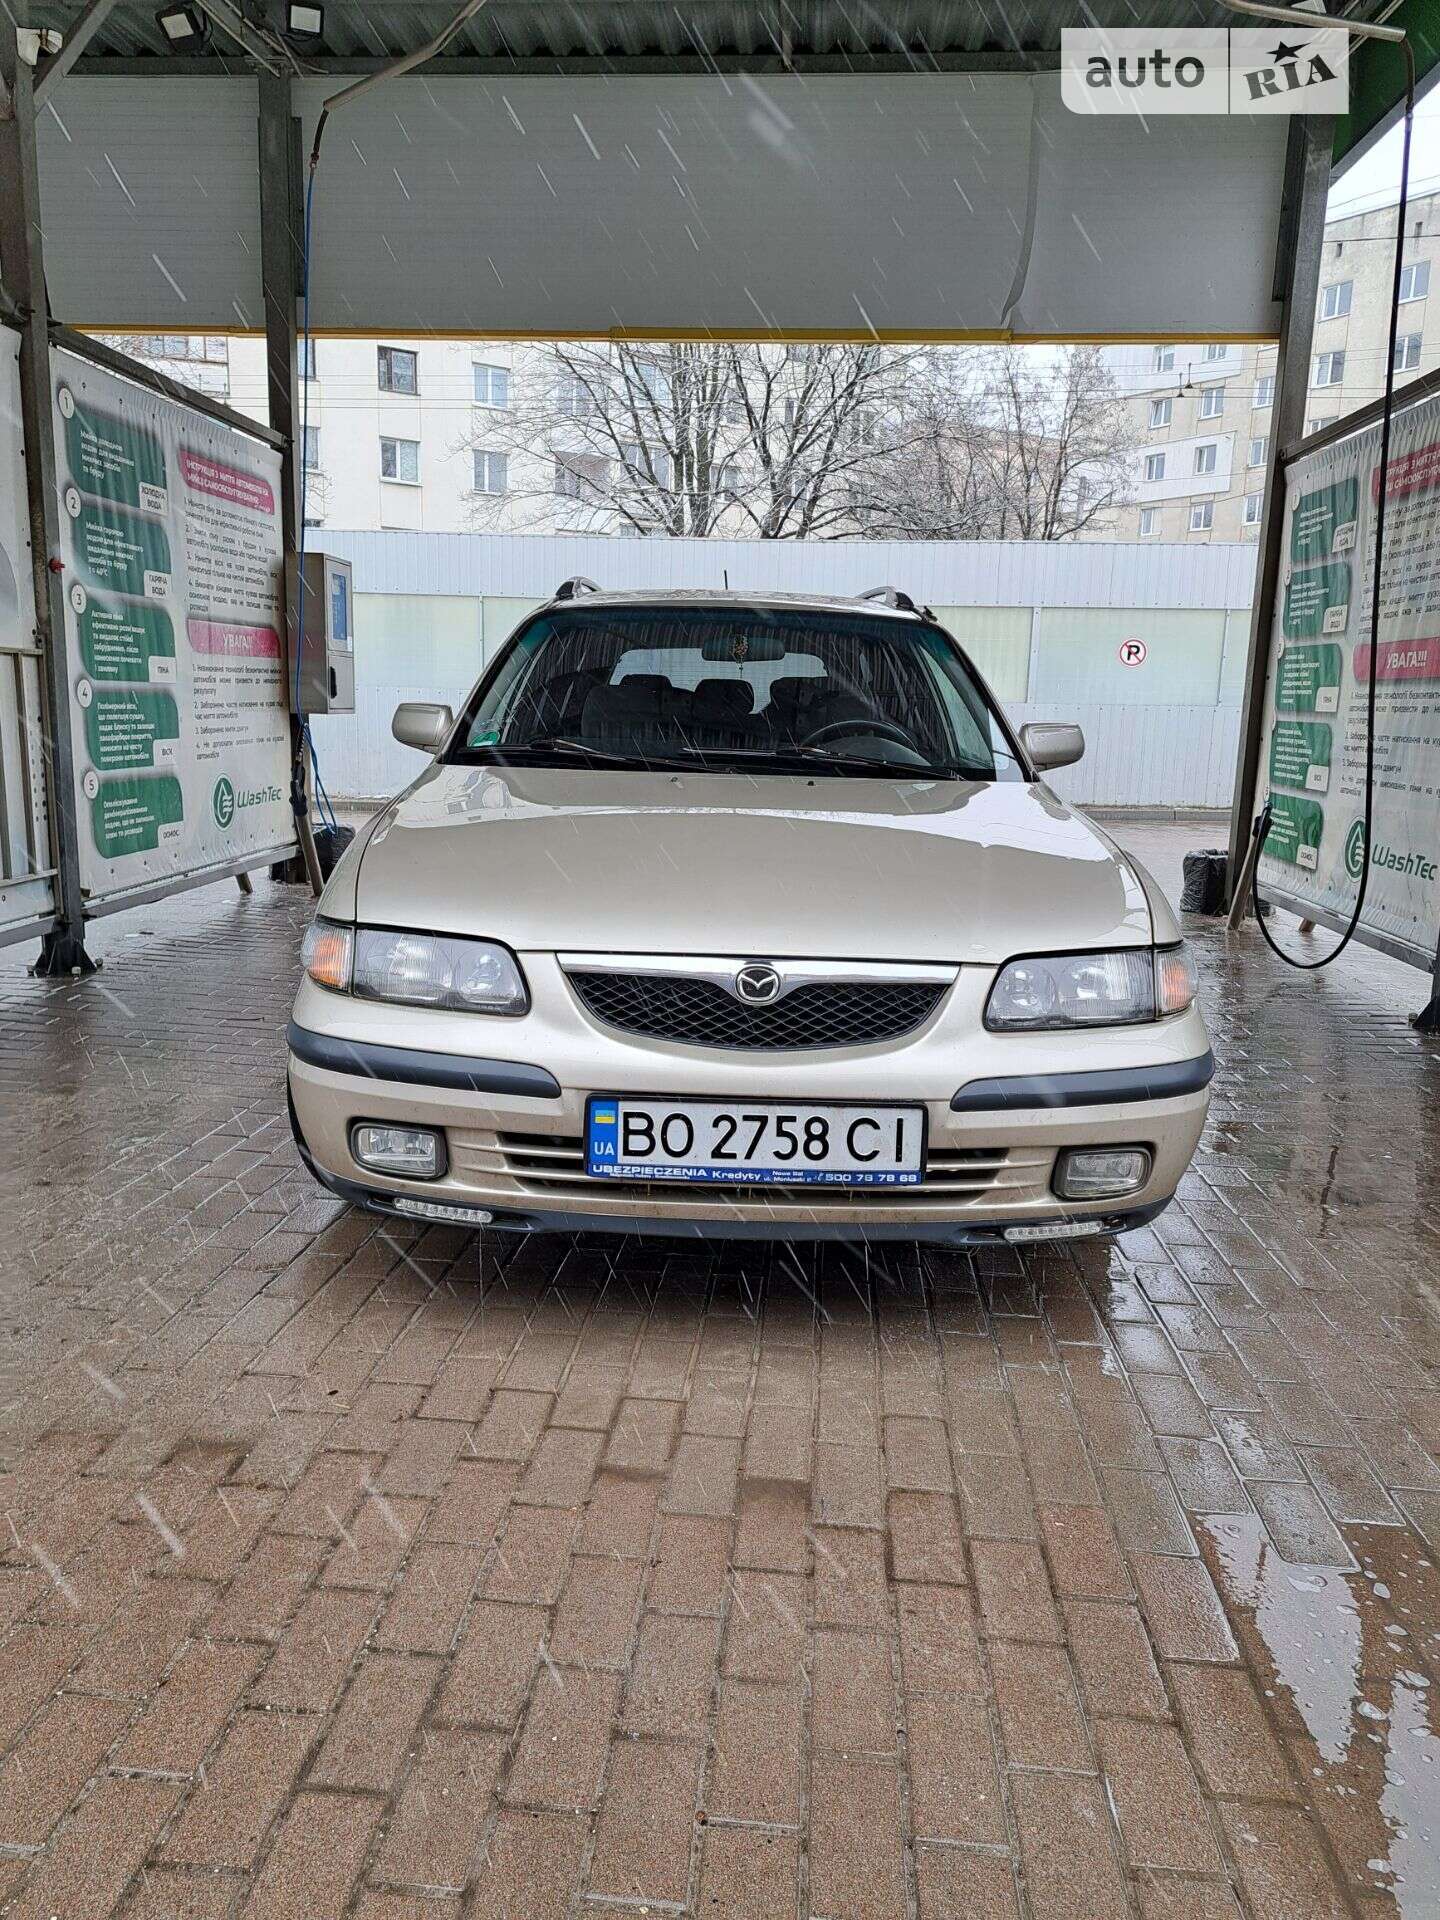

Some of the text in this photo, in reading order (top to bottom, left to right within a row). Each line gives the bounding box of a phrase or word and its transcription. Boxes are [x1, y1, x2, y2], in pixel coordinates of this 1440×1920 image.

[70, 496, 77, 509] 2
[76, 593, 82, 606] 3
[1386, 649, 1428, 669] УВАГА!!!
[82, 687, 88, 700] 4
[88, 779, 95, 791] 5
[237, 786, 282, 809] WashTec
[1371, 843, 1440, 881] WashTec
[623, 1111, 904, 1163] BO 2758 CI
[594, 1141, 615, 1156] UA
[593, 1164, 708, 1177] UBEZPIECZENIA
[712, 1171, 761, 1183] Kredyty
[825, 1173, 852, 1182] 500
